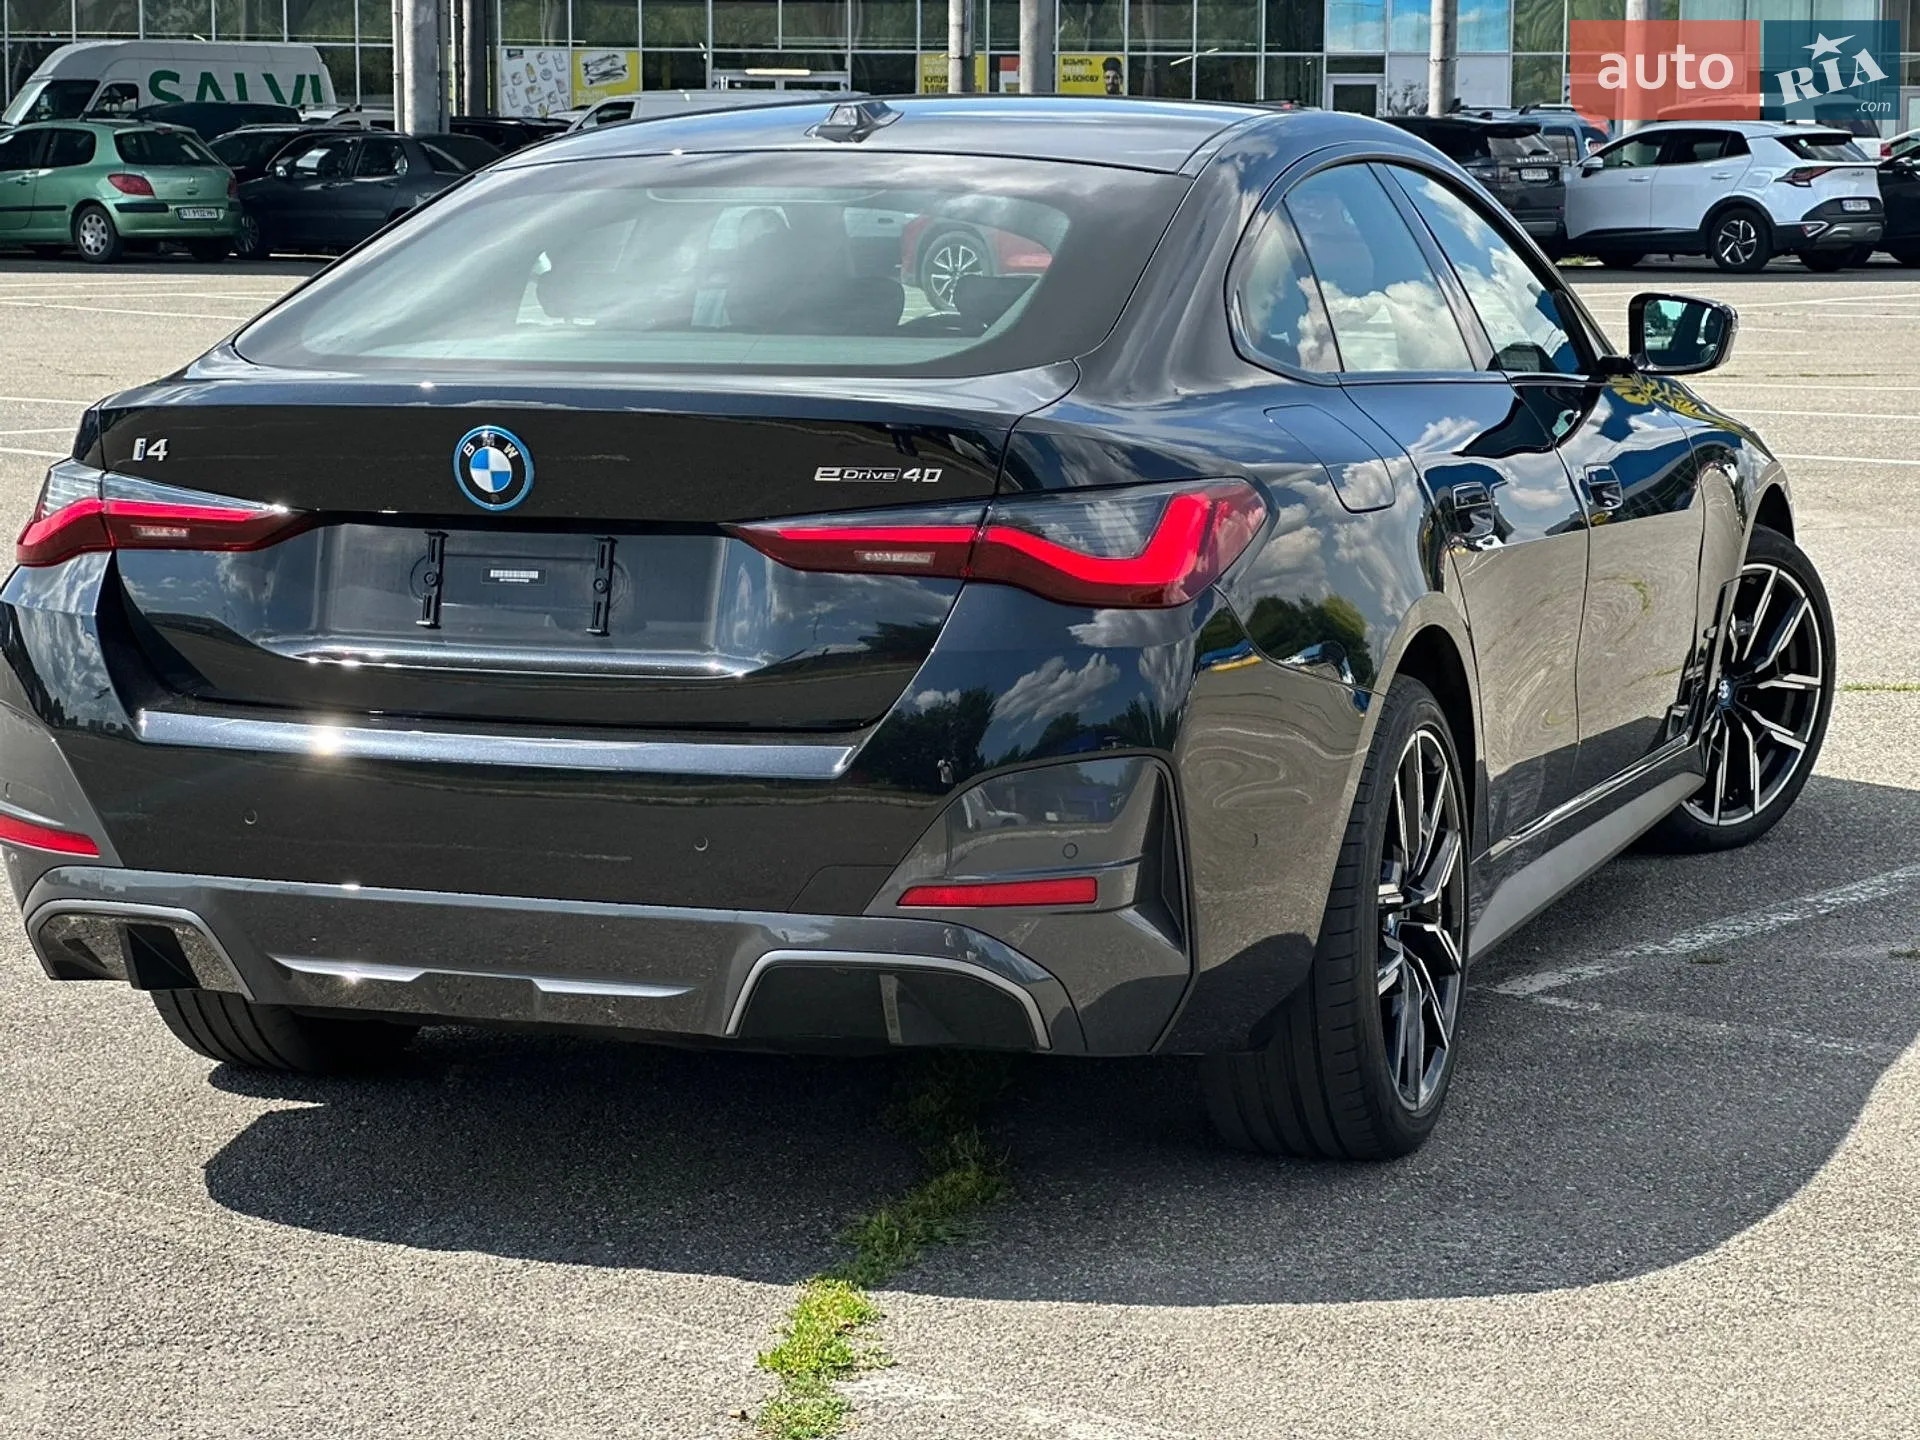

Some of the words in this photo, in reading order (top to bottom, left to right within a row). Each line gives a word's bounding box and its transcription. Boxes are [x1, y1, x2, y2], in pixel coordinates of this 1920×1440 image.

[132, 437, 168, 461] i4
[462, 433, 519, 459] BMW
[902, 467, 943, 482] 40
